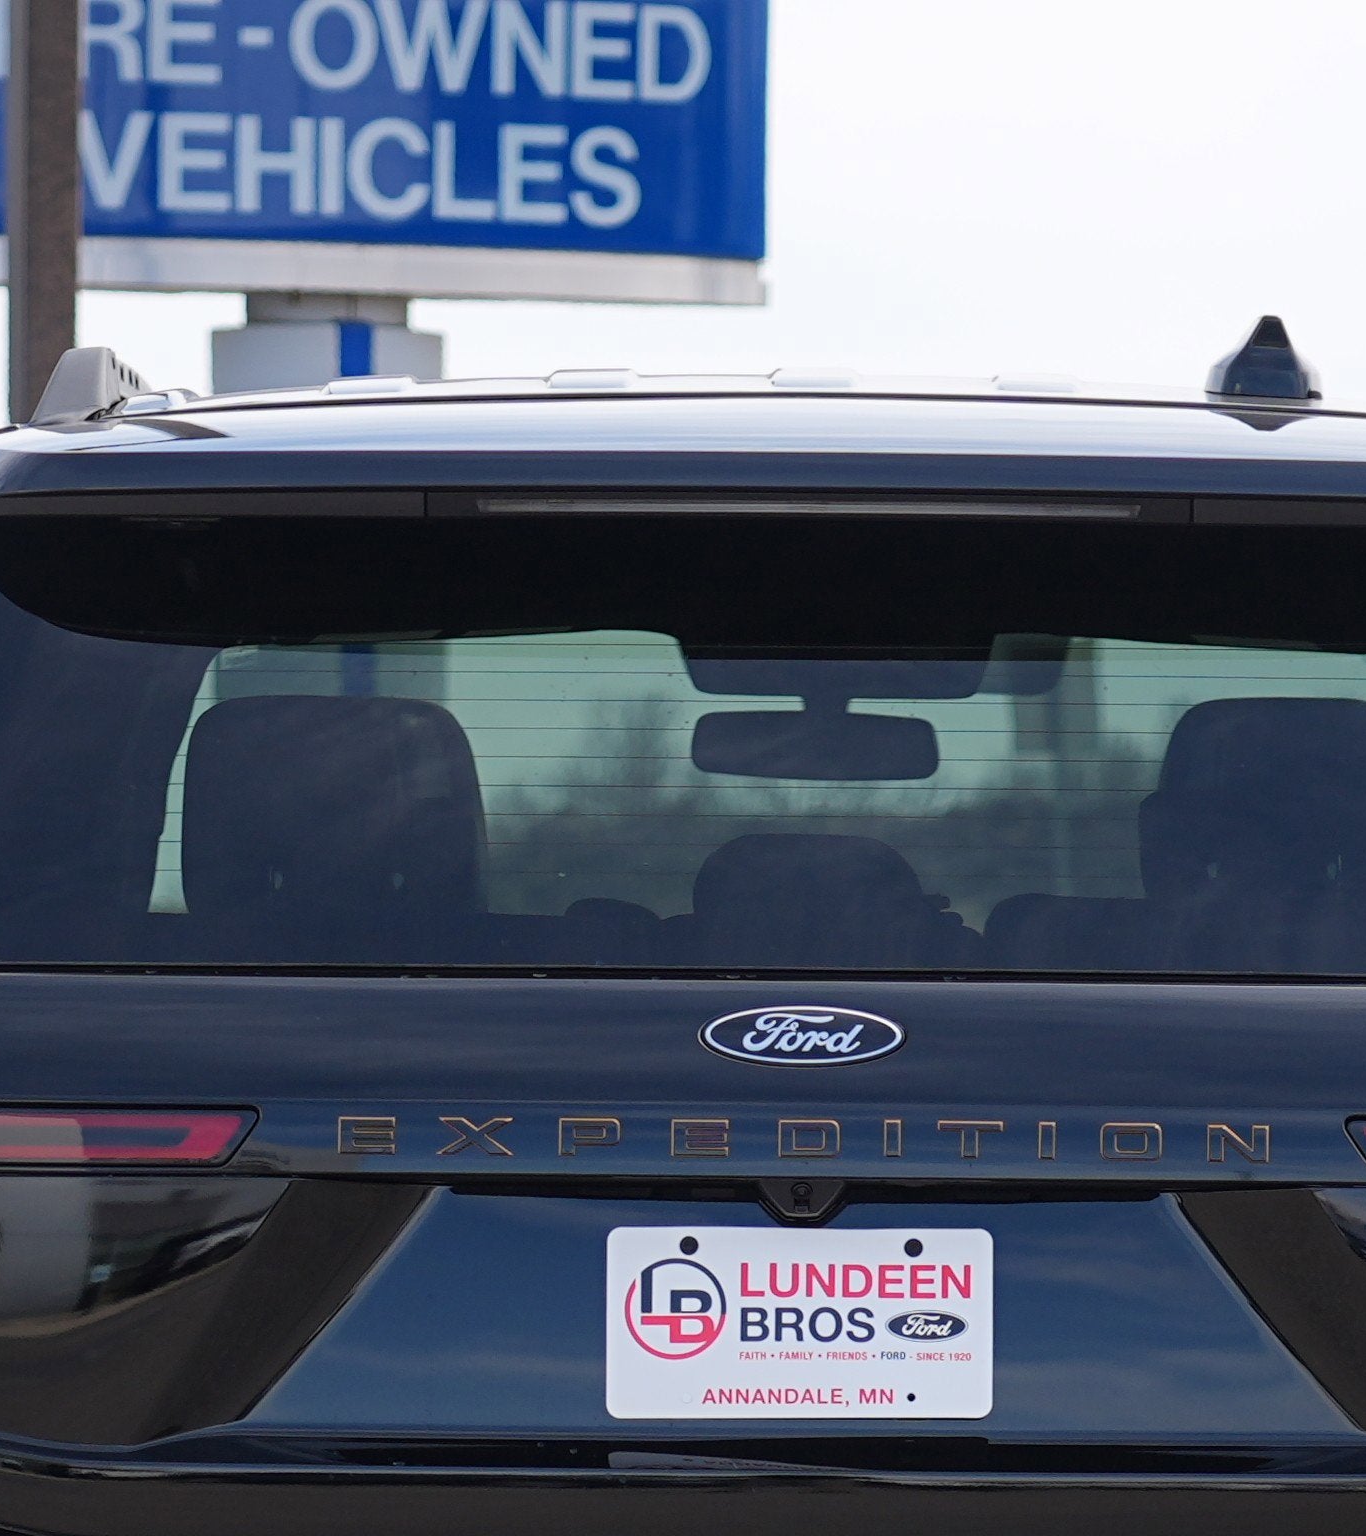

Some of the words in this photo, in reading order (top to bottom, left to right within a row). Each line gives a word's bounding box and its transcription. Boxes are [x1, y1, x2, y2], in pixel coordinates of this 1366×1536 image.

[77, 110, 641, 228] VEHICLES
[742, 1012, 861, 1055] Ford
[337, 1115, 1271, 1164] EXPEDITION
[739, 1262, 972, 1299] LUNDEEN
[739, 1306, 875, 1343] BROS
[739, 1351, 767, 1360] FAITH
[779, 1351, 813, 1360] FAMILY
[826, 1351, 868, 1361] FRIENDS
[880, 1351, 906, 1360] FORD
[916, 1352, 945, 1361] SINCE
[948, 1352, 972, 1362] 1920
[702, 1389, 850, 1406] ANNANDALE,
[859, 1388, 894, 1404] MN
